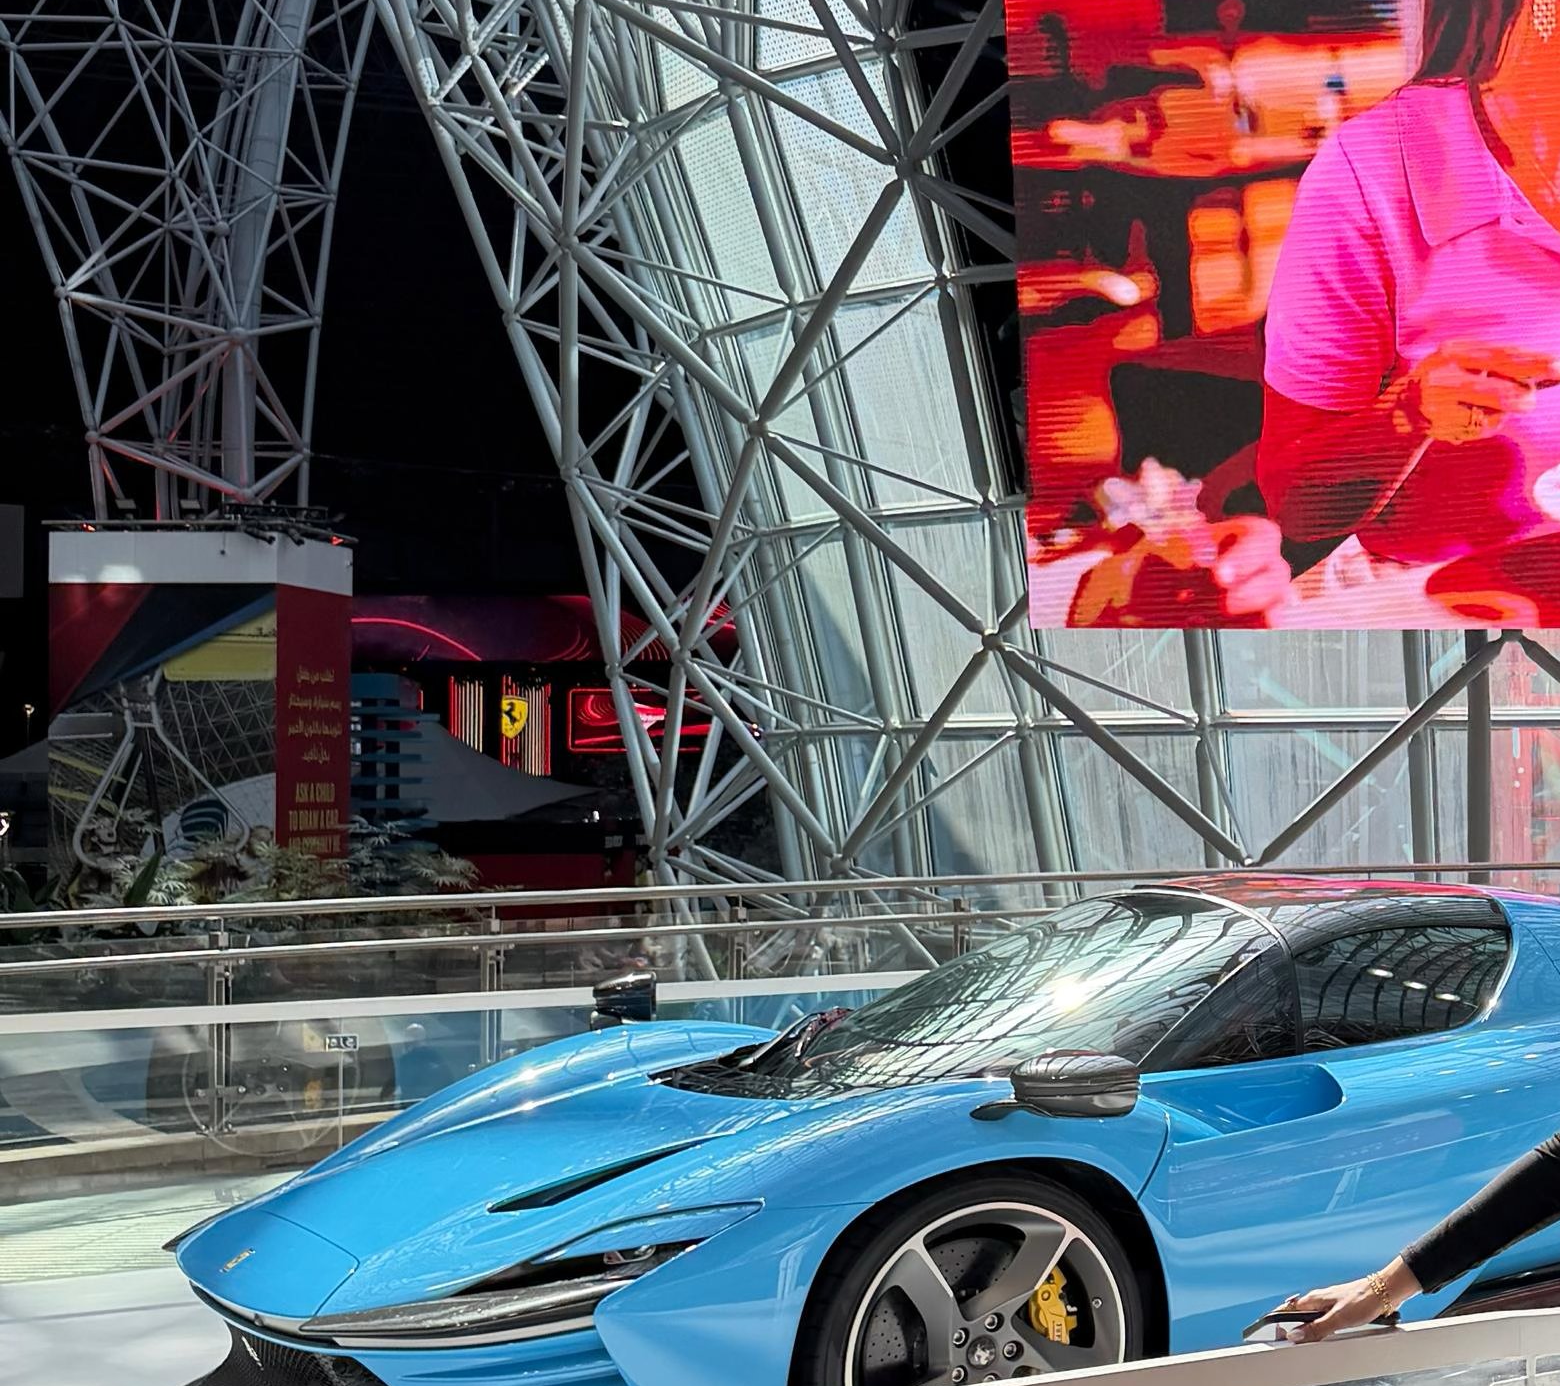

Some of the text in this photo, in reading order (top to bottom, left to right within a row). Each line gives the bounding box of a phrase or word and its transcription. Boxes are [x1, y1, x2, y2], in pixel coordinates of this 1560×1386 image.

[296, 782, 309, 803] ASK
[315, 782, 335, 803] CHILD
[289, 810, 299, 831] TO
